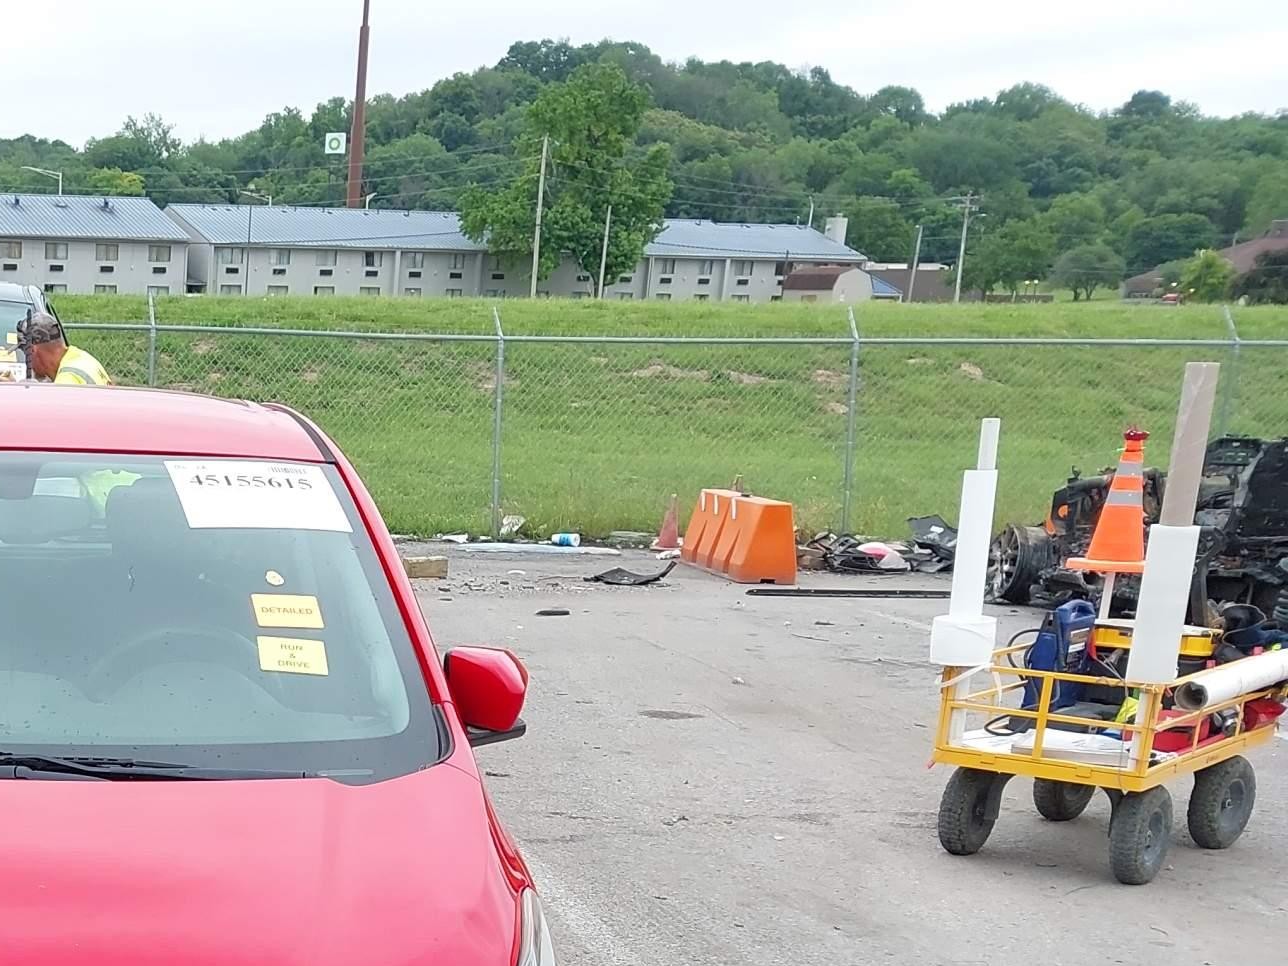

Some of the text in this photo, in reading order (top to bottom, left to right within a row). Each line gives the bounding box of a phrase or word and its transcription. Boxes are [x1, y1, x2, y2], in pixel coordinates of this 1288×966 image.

[189, 474, 313, 490] 45155615
[260, 606, 313, 615] DETAILED
[280, 643, 304, 651] RUN
[277, 660, 311, 669] DRIVE
